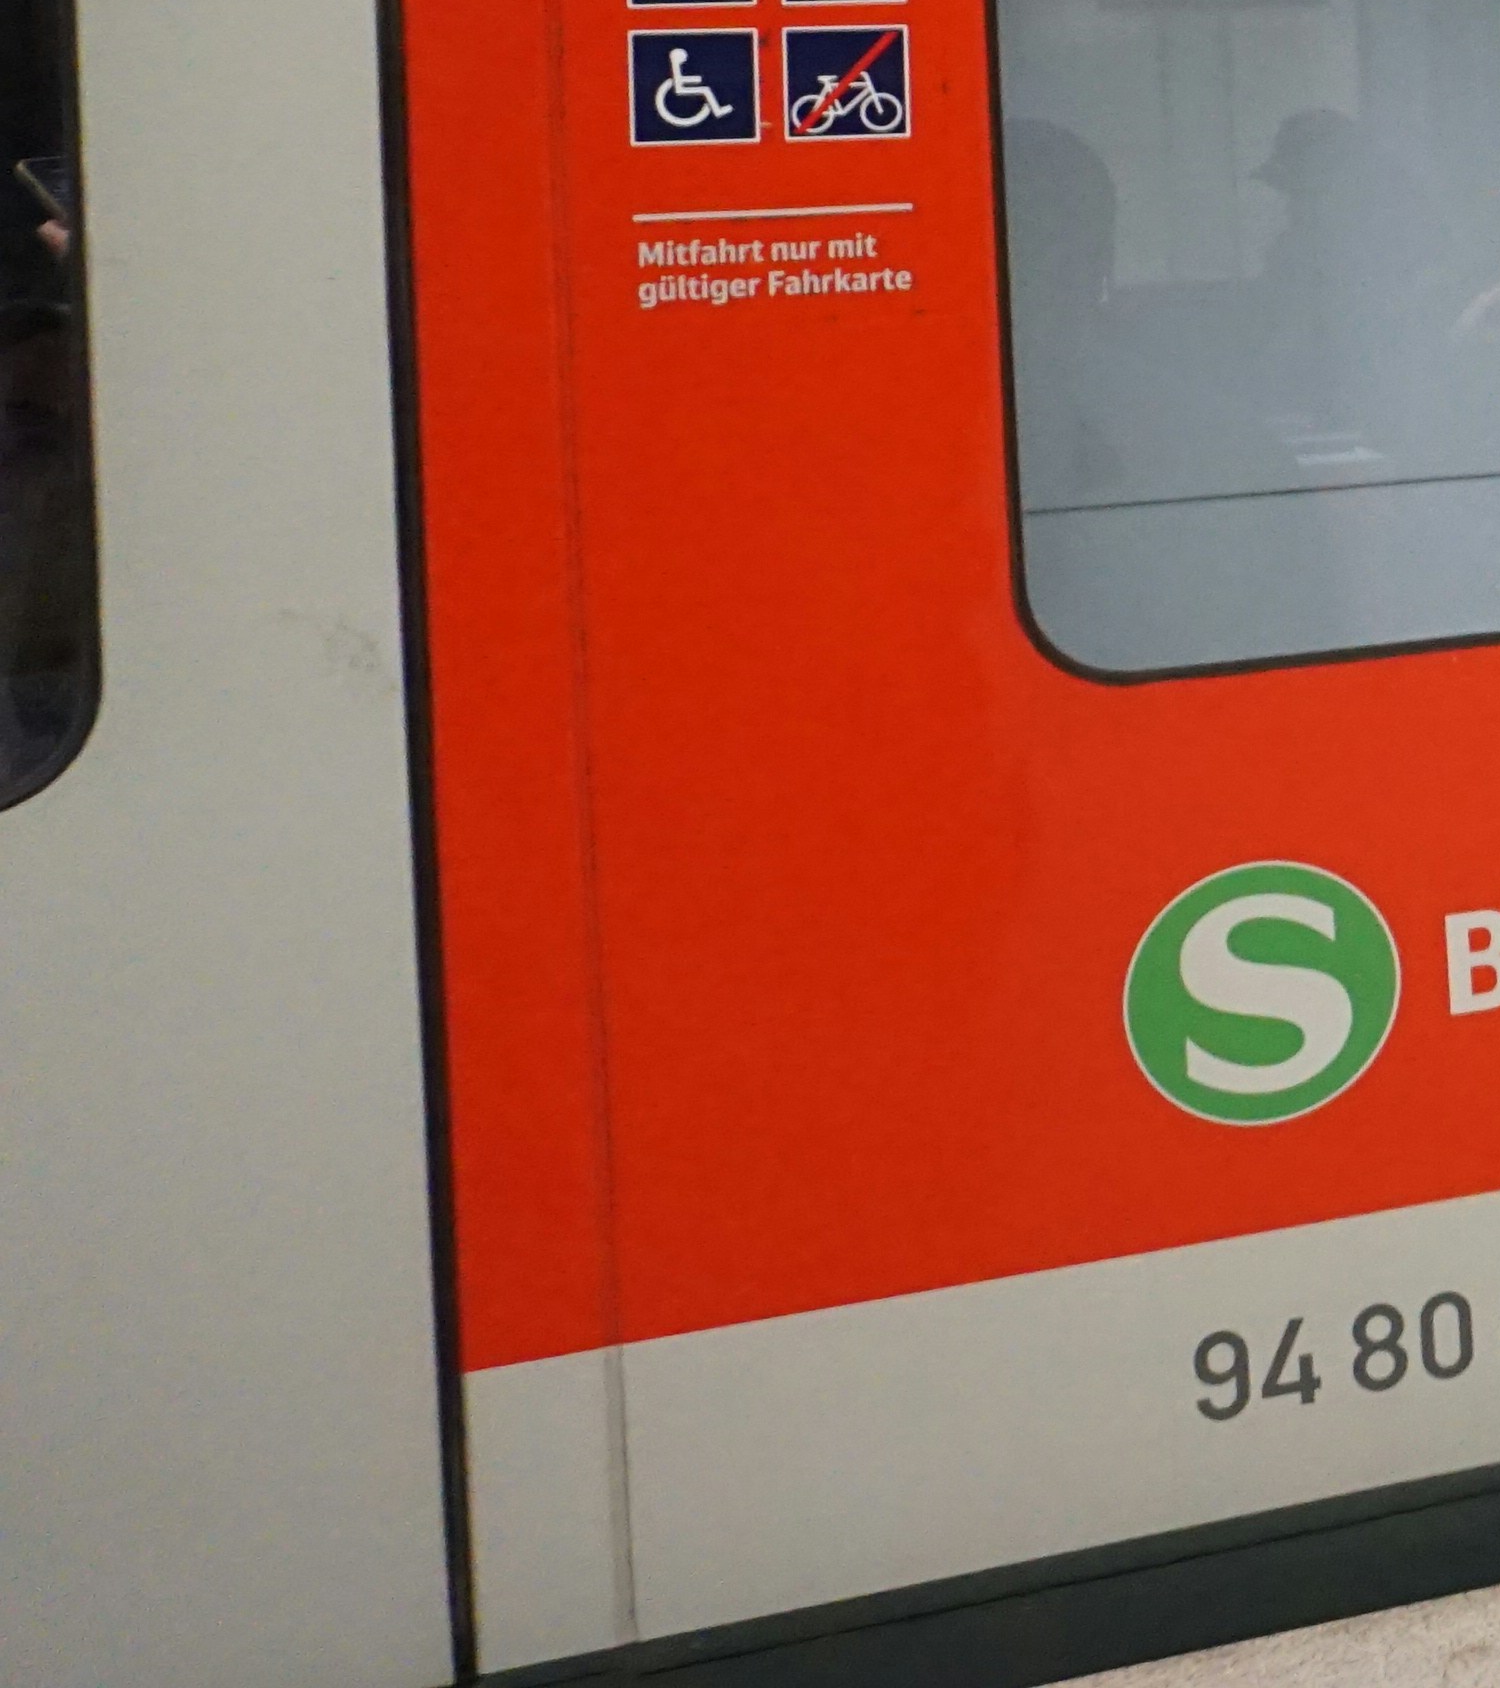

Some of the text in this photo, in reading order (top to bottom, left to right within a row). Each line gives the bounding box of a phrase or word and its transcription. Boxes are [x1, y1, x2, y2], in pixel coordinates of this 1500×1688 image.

[637, 232, 876, 268] Mitfahrt nur mit
[638, 268, 912, 308] gültiger Fahrkarte
[1178, 892, 1353, 1094] S
[1193, 1318, 1321, 1421] 94
[1351, 1291, 1474, 1391] 80
